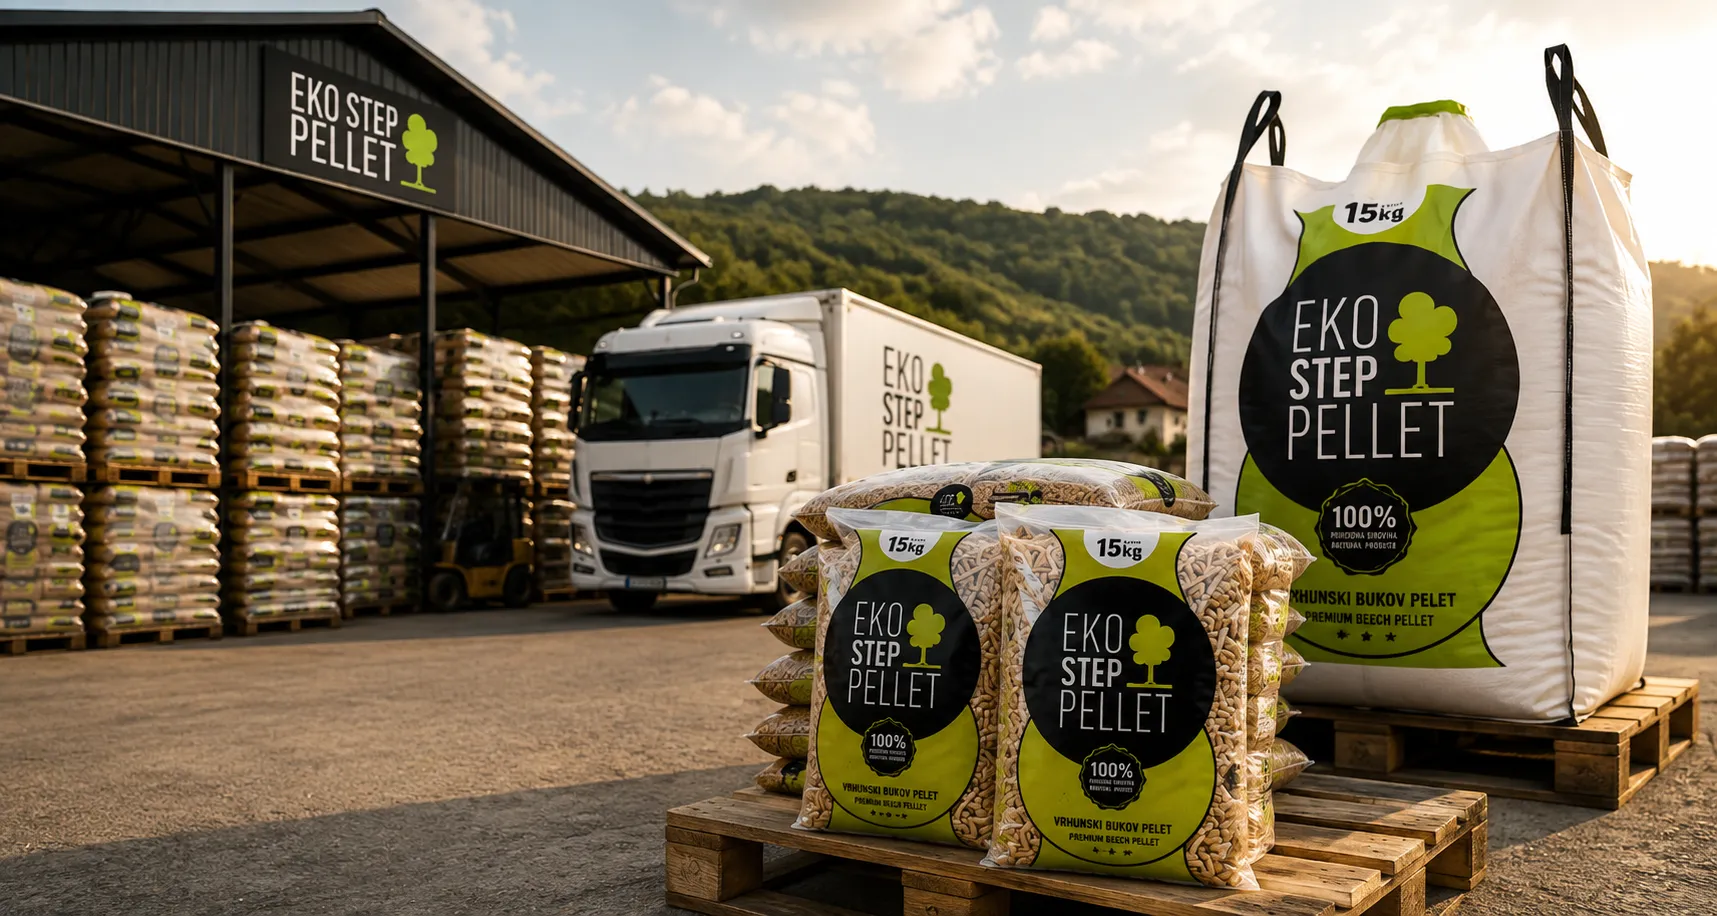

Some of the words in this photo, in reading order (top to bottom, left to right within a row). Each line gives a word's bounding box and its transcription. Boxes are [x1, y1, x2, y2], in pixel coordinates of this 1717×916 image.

[291, 71, 339, 122] EKO
[346, 92, 398, 138] STEP
[290, 113, 397, 182] PELLET
[1345, 202, 1404, 223] 15kg
[1292, 294, 1379, 354] EKO
[883, 345, 923, 394] EKO
[1289, 355, 1378, 401] STEP
[882, 391, 924, 430] STEP
[1288, 400, 1454, 460] PELLET
[882, 430, 952, 469] PELLET
[1332, 505, 1397, 528] 100%
[888, 536, 925, 556] 15kg
[1097, 538, 1142, 561] 15kg
[1356, 592, 1405, 607] BUKOV
[1411, 592, 1456, 607] PELET
[854, 601, 903, 637] EKO
[1063, 613, 1122, 654] EKO
[1305, 610, 1352, 624] PREMIUM
[1356, 613, 1391, 626] BEECH
[1394, 614, 1434, 626] PELLET
[851, 639, 900, 667] STEP
[1061, 656, 1122, 687] STEP
[848, 668, 941, 709] PELLET
[1059, 689, 1172, 733] PELLET
[871, 733, 906, 749] 100%
[1090, 761, 1133, 778] 100%
[883, 786, 911, 798] BUKOV
[913, 789, 938, 801] PELET
[1054, 816, 1102, 830] VRHUNSKI
[1106, 821, 1139, 833] BUKOV
[1142, 823, 1172, 835] PELET
[1132, 837, 1160, 847] PELLET
